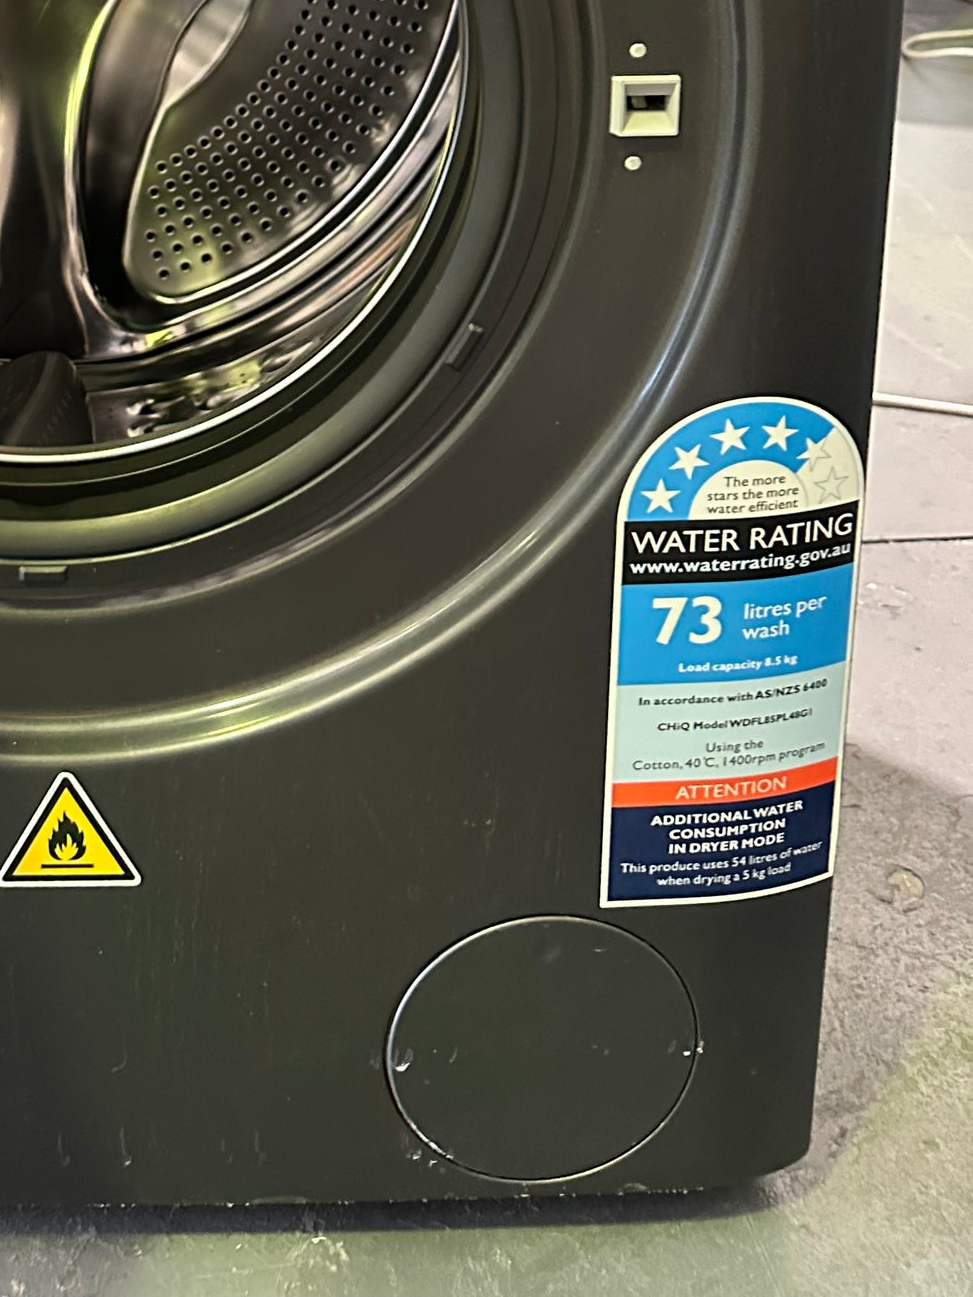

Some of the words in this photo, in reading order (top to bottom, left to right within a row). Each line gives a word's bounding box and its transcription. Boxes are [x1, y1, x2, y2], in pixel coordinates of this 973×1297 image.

[724, 476, 749, 487] The
[752, 475, 786, 486] more
[707, 492, 739, 502] stars
[742, 489, 761, 500] the
[764, 487, 799, 498] more
[707, 505, 744, 514] water
[748, 500, 799, 512] efficient
[631, 530, 739, 554] WATER
[750, 512, 853, 550] RATING
[630, 543, 851, 574] www.waterrating.gov.au
[652, 595, 723, 645] 73
[743, 601, 791, 620] litres
[795, 596, 827, 619] per
[742, 621, 789, 640] wash
[678, 662, 710, 673] Load
[713, 659, 762, 672] capacity
[764, 656, 781, 667] 8.5
[784, 654, 798, 666] kg
[638, 697, 651, 706] In
[654, 694, 724, 706] accordance
[727, 691, 753, 702] with
[755, 685, 800, 700] AS/NZS
[803, 678, 828, 692] 6400
[658, 721, 690, 732] CHiQ
[693, 719, 728, 730] Model
[632, 760, 683, 771] Cotton,
[723, 753, 776, 767] 1400rpm
[779, 742, 826, 762] program
[706, 742, 741, 754] Using
[743, 739, 763, 751] the
[675, 775, 787, 800] ATTENTION
[651, 811, 752, 826] ADDITIONAL
[754, 800, 803, 819] WATER
[669, 818, 786, 840] CONSUMPTION
[668, 844, 686, 855] IN
[689, 841, 739, 853] DRYER
[741, 833, 785, 849] MODE
[621, 862, 647, 873] This
[649, 861, 700, 874] produce
[703, 859, 729, 870] uses
[732, 856, 747, 868] 54
[749, 852, 777, 865] litres
[780, 848, 791, 859] of
[793, 840, 823, 856] water
[657, 875, 691, 886] when
[693, 872, 731, 886] drying
[733, 873, 740, 881] a
[742, 868, 750, 880] 5
[752, 867, 766, 881] kg
[768, 863, 791, 875] load
